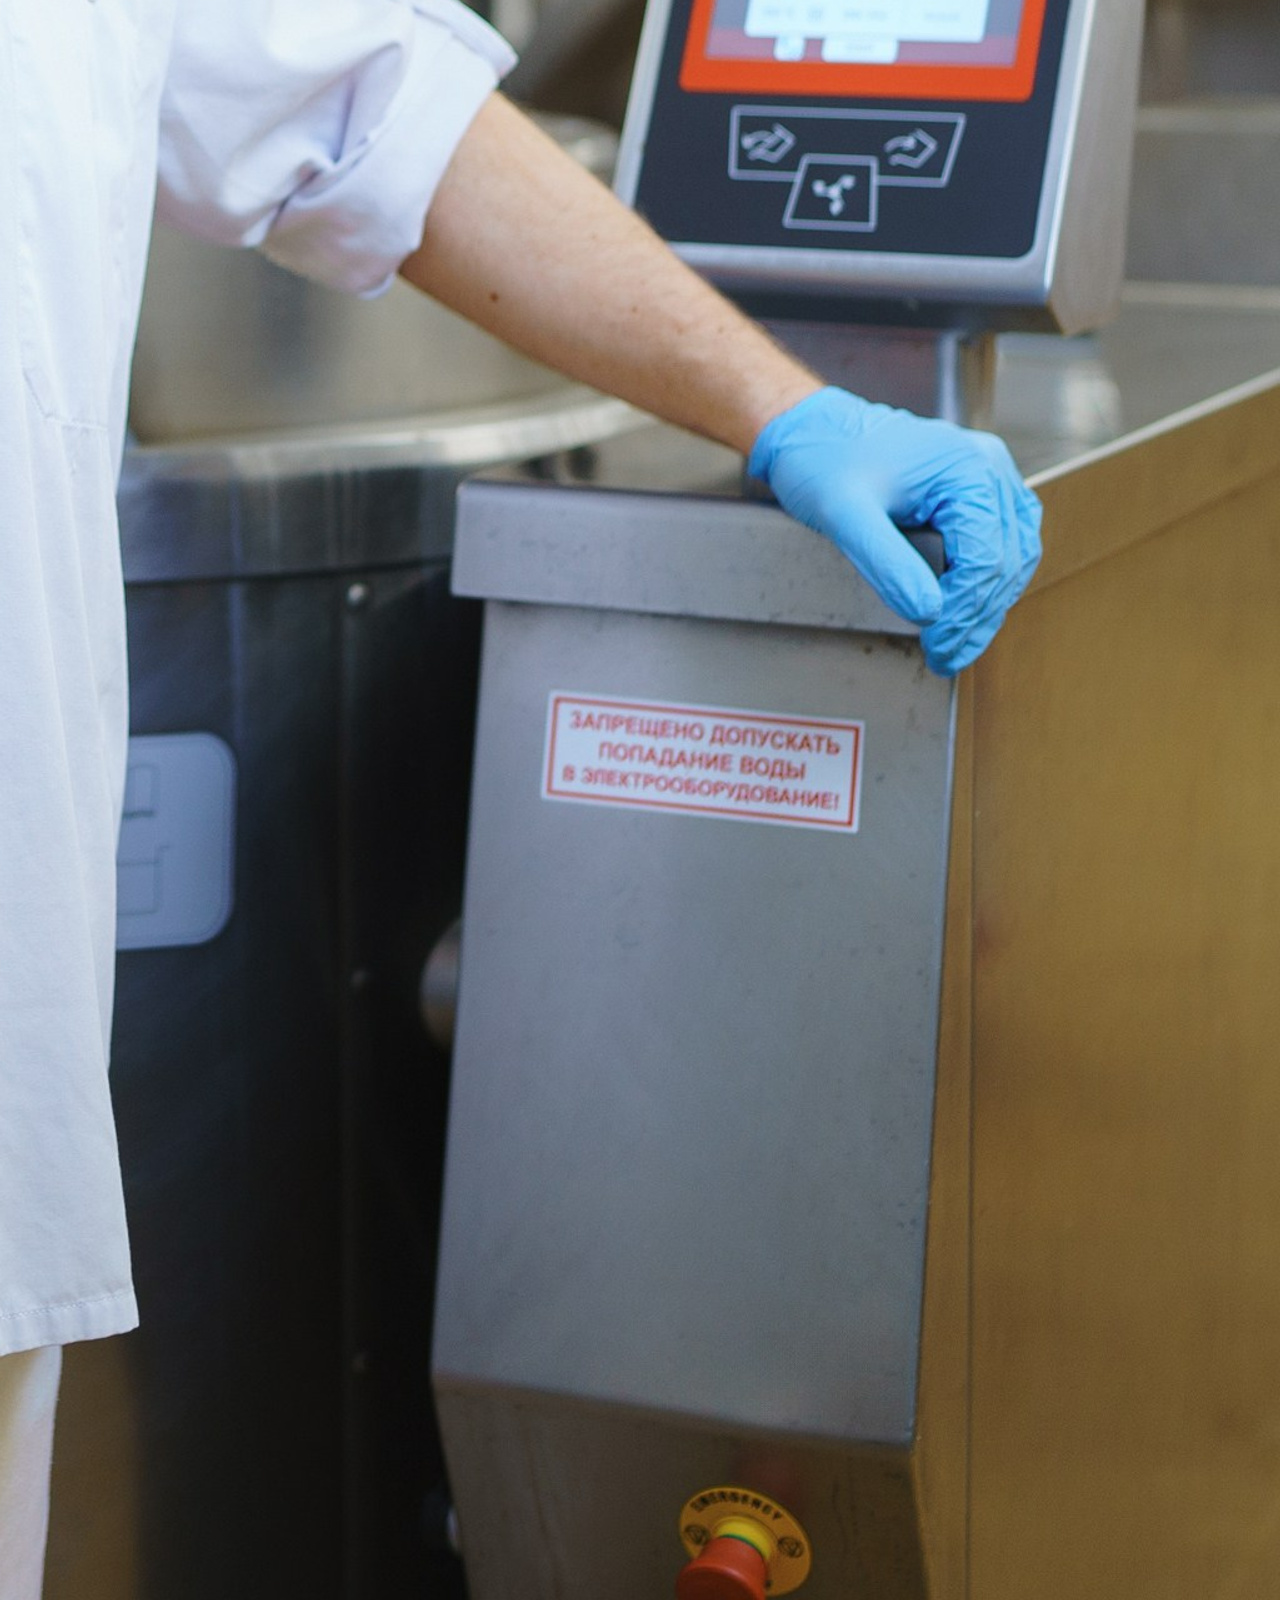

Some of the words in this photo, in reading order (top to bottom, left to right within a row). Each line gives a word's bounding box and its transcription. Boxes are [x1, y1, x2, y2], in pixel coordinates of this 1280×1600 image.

[570, 711, 704, 739] ЗАПРЕЩЕНО
[709, 727, 840, 755] ДОПУСКАТЬ
[599, 742, 732, 773] ПОПАДАНИЕ
[740, 756, 806, 780] ВОДЫ
[563, 766, 574, 782] В
[582, 767, 839, 811] ЭЛЕКТРООБОРУДОВАНИЕ!
